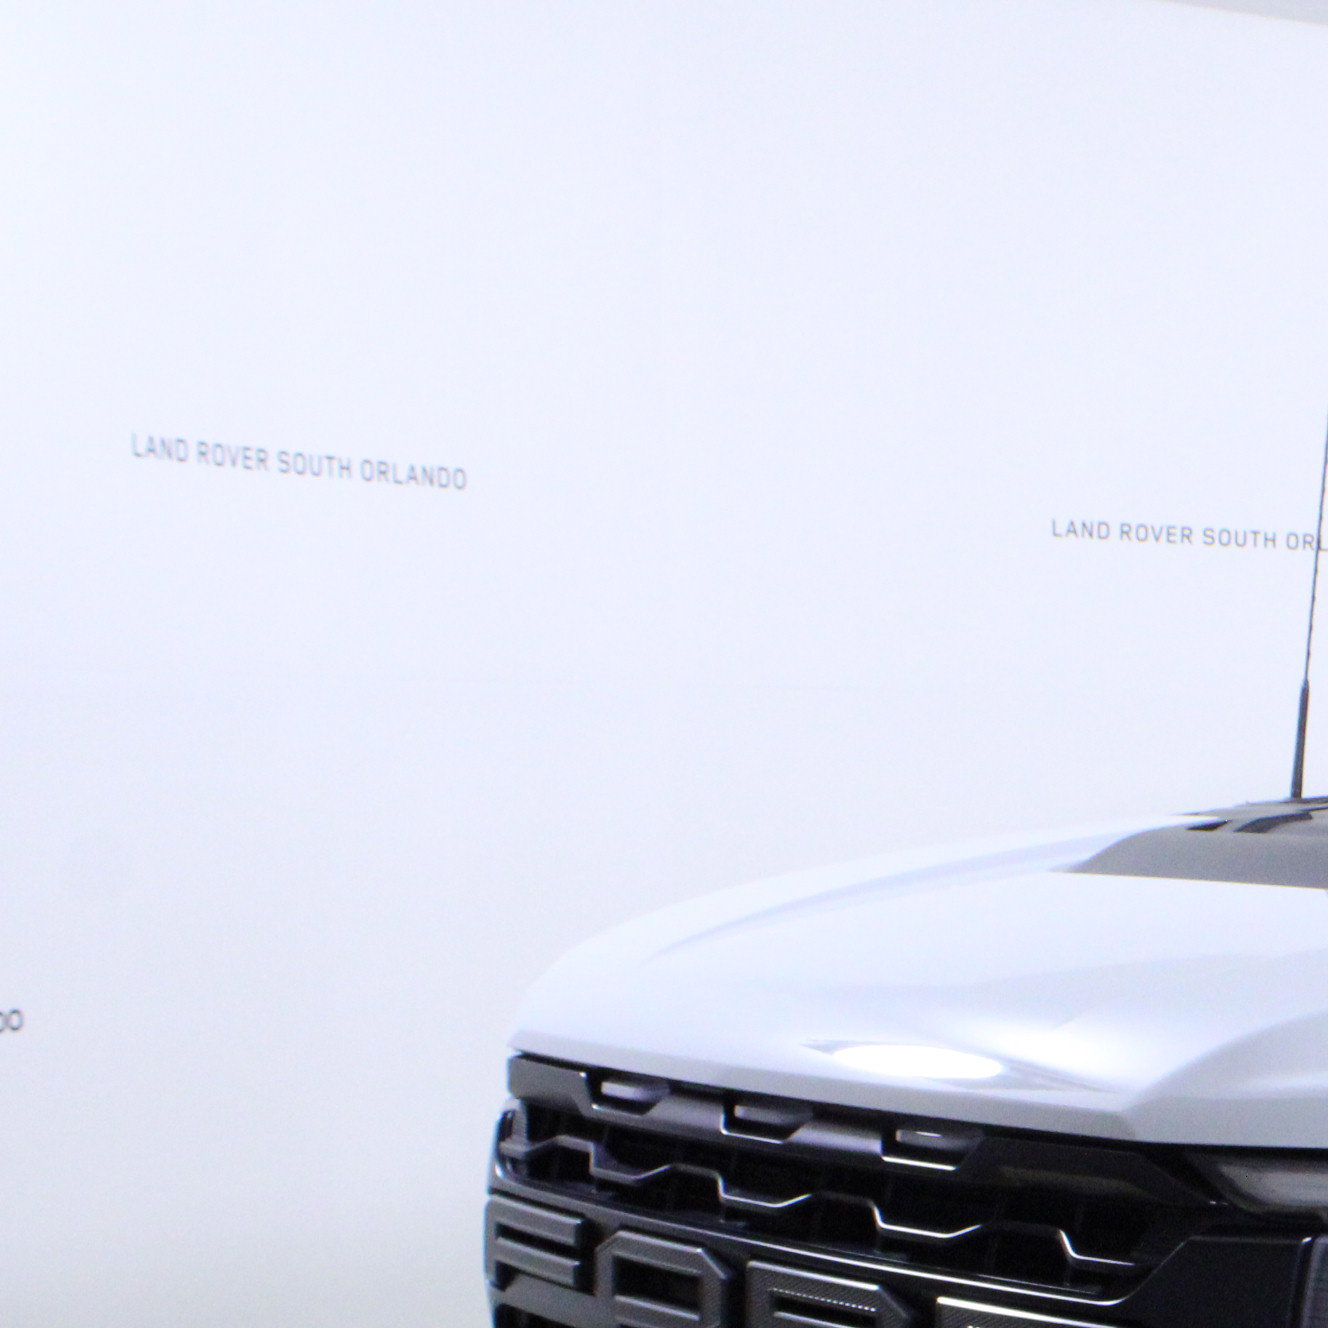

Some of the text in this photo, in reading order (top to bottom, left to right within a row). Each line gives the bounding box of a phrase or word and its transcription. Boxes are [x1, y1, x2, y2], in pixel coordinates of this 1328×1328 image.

[131, 433, 468, 491] LAND ROVER SOUTH ORLANDO
[1051, 519, 1111, 540] LAND
[1119, 522, 1193, 545] ROVER
[1203, 527, 1277, 549] SOUTH
